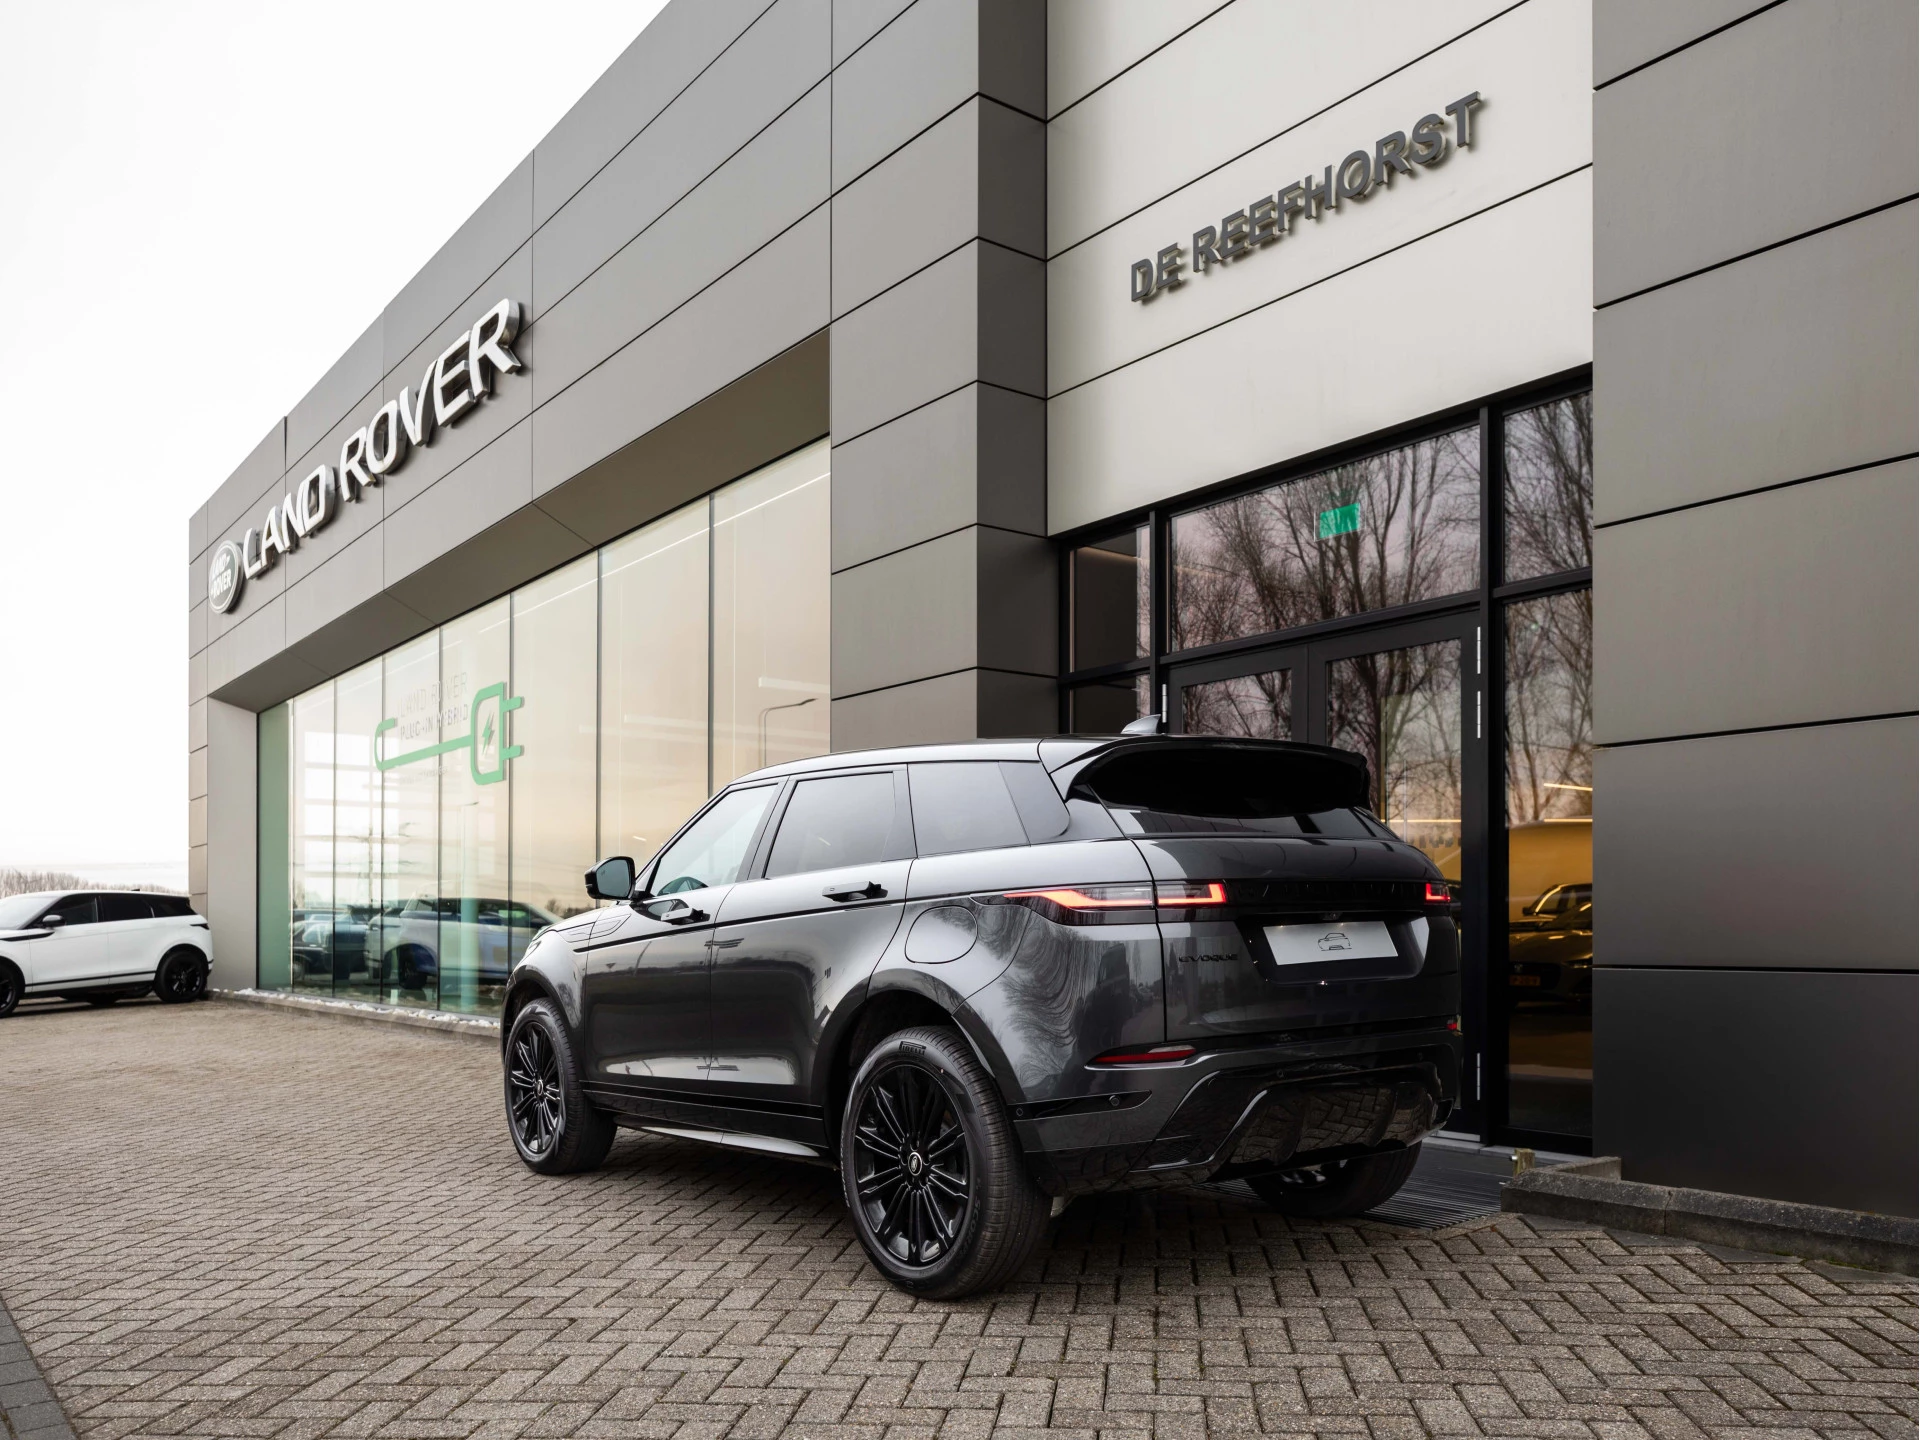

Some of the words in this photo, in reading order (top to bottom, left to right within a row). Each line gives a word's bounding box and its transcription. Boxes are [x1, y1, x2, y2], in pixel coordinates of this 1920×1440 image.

[1131, 242, 1181, 302] DE
[1193, 91, 1481, 272] REEFHORST
[243, 464, 335, 579] LAND
[340, 298, 522, 502] ROVER
[400, 716, 433, 740] PLUG-IN
